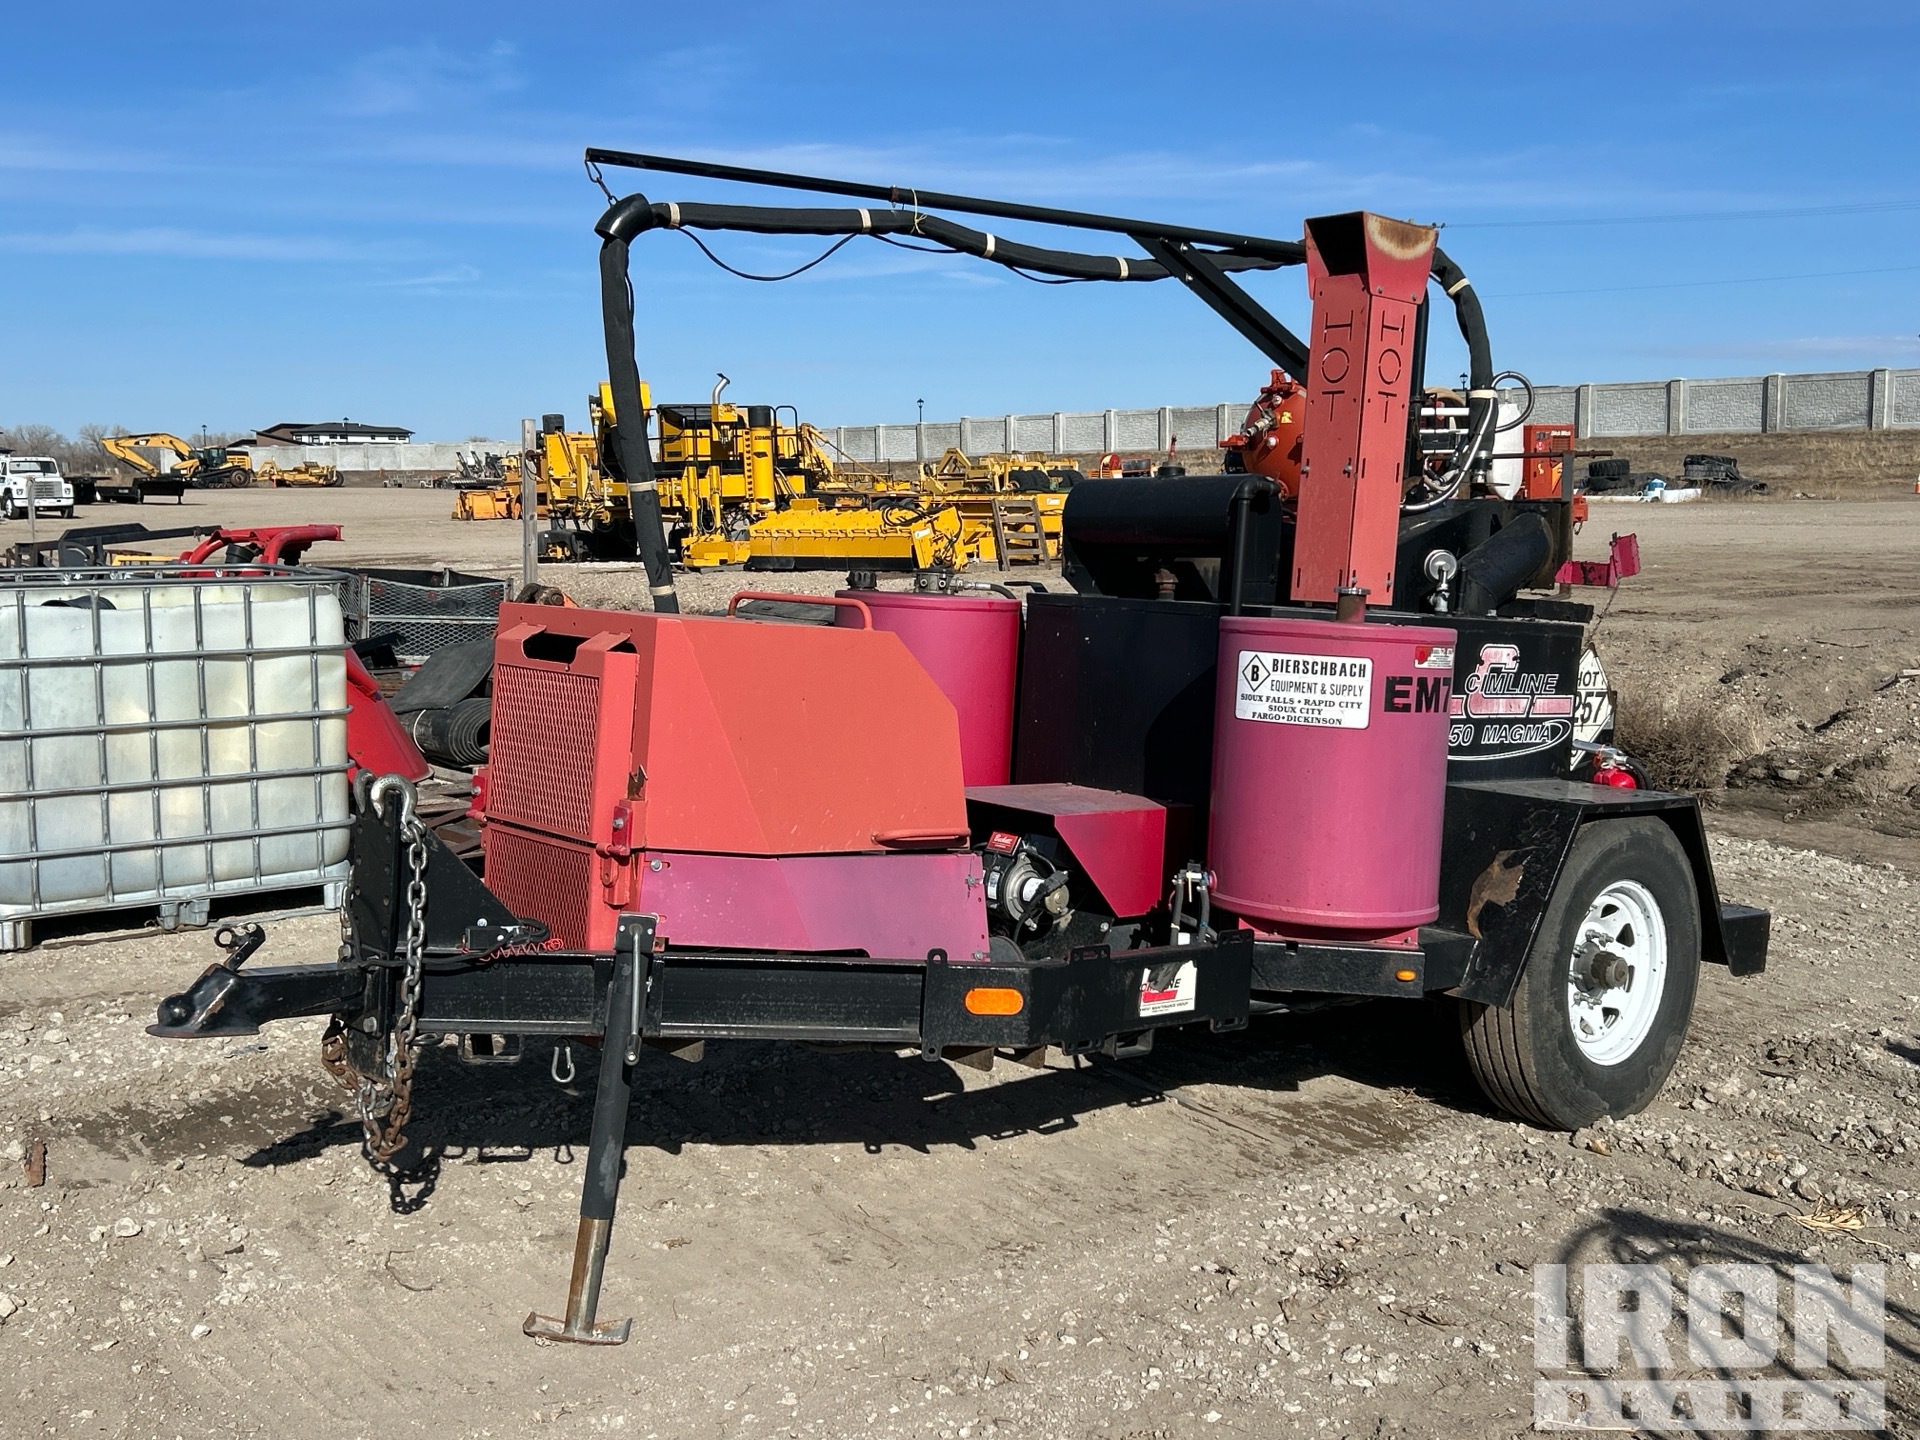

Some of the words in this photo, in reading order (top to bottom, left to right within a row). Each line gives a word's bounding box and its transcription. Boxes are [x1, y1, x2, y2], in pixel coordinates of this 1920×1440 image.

[1322, 310, 1354, 422] HOT
[1378, 310, 1406, 423] HOT
[1272, 658, 1367, 678] BIERSCHBACH
[1270, 679, 1318, 695] EQUIPMENT
[1320, 683, 1327, 695] &
[1329, 683, 1364, 697] SUPPLY
[1464, 673, 1560, 695] CIMLINE
[1240, 693, 1263, 702] SIOUX
[1265, 695, 1295, 705] FALLS
[1303, 698, 1335, 708] RAPID
[1338, 701, 1363, 709] CITY
[1268, 704, 1297, 714] SIOUX
[1299, 707, 1324, 716] CITY
[1481, 724, 1552, 744] MAGMA
